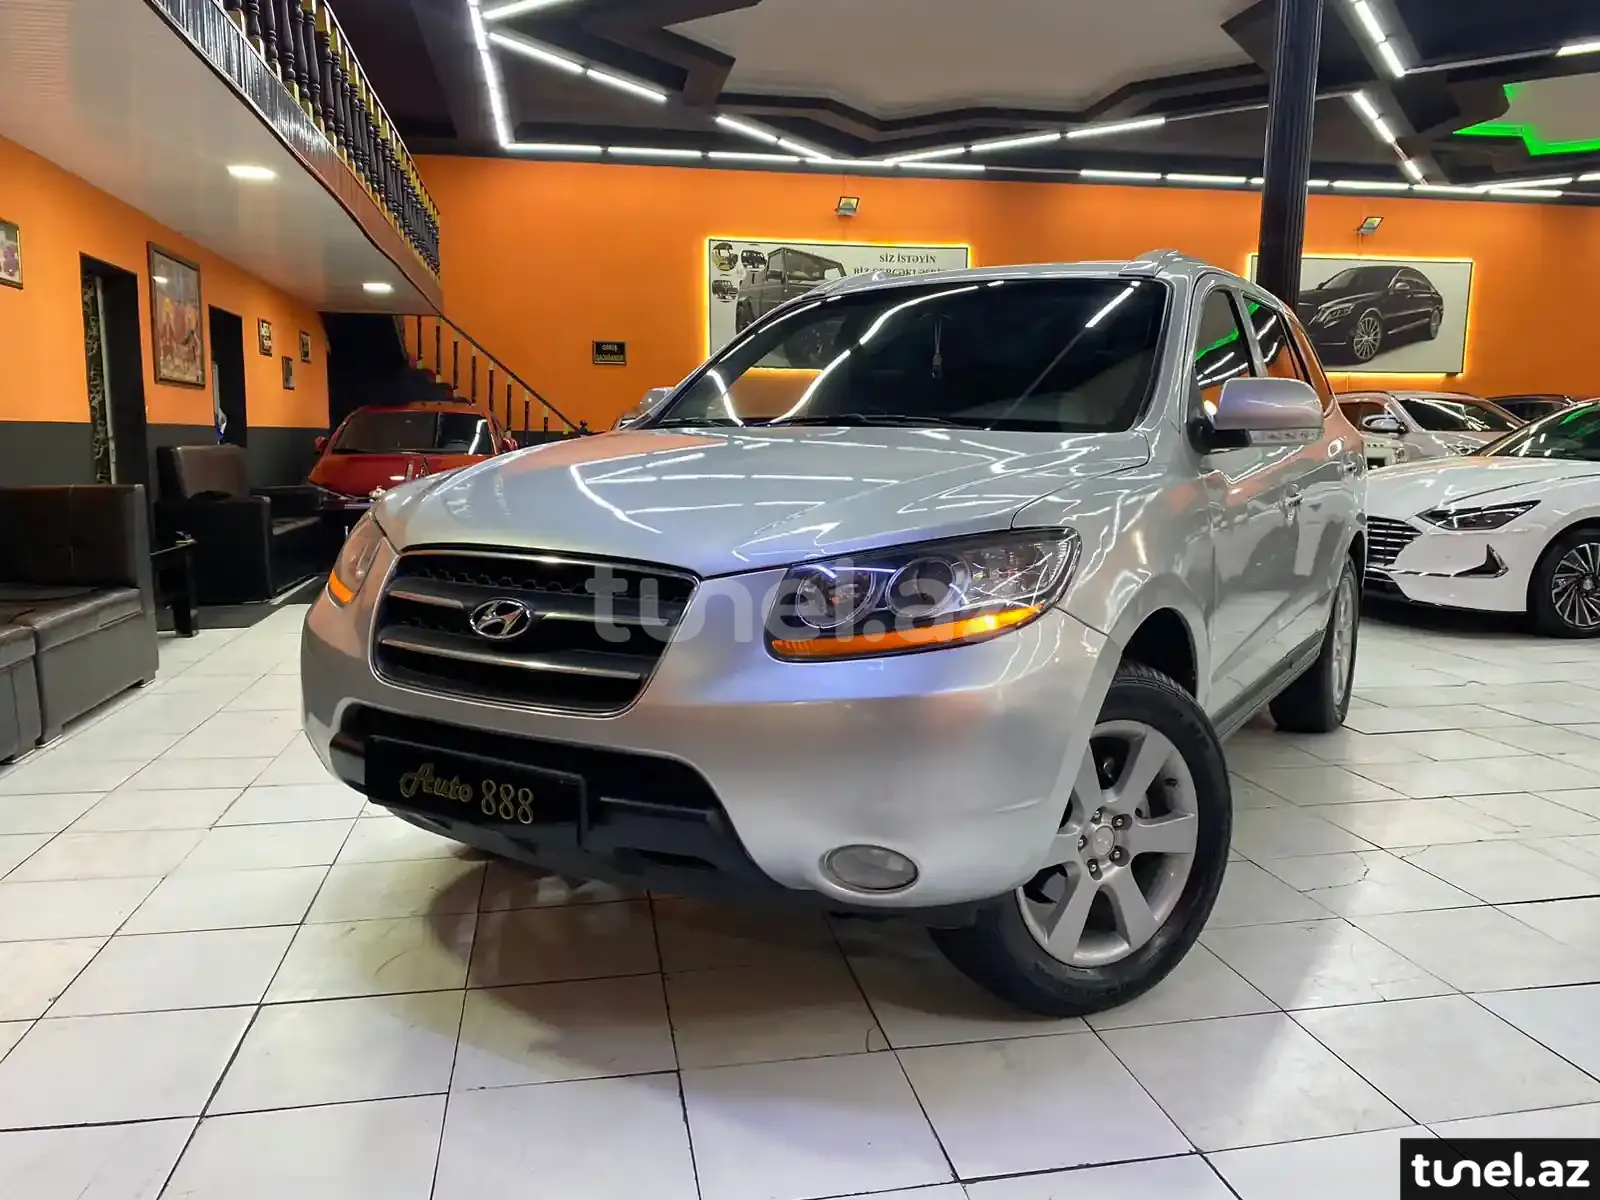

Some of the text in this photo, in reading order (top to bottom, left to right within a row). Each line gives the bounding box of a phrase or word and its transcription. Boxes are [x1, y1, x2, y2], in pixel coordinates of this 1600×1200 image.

[880, 252, 937, 264] SİZ İSTƏYİN
[400, 763, 534, 824] Auto 888
